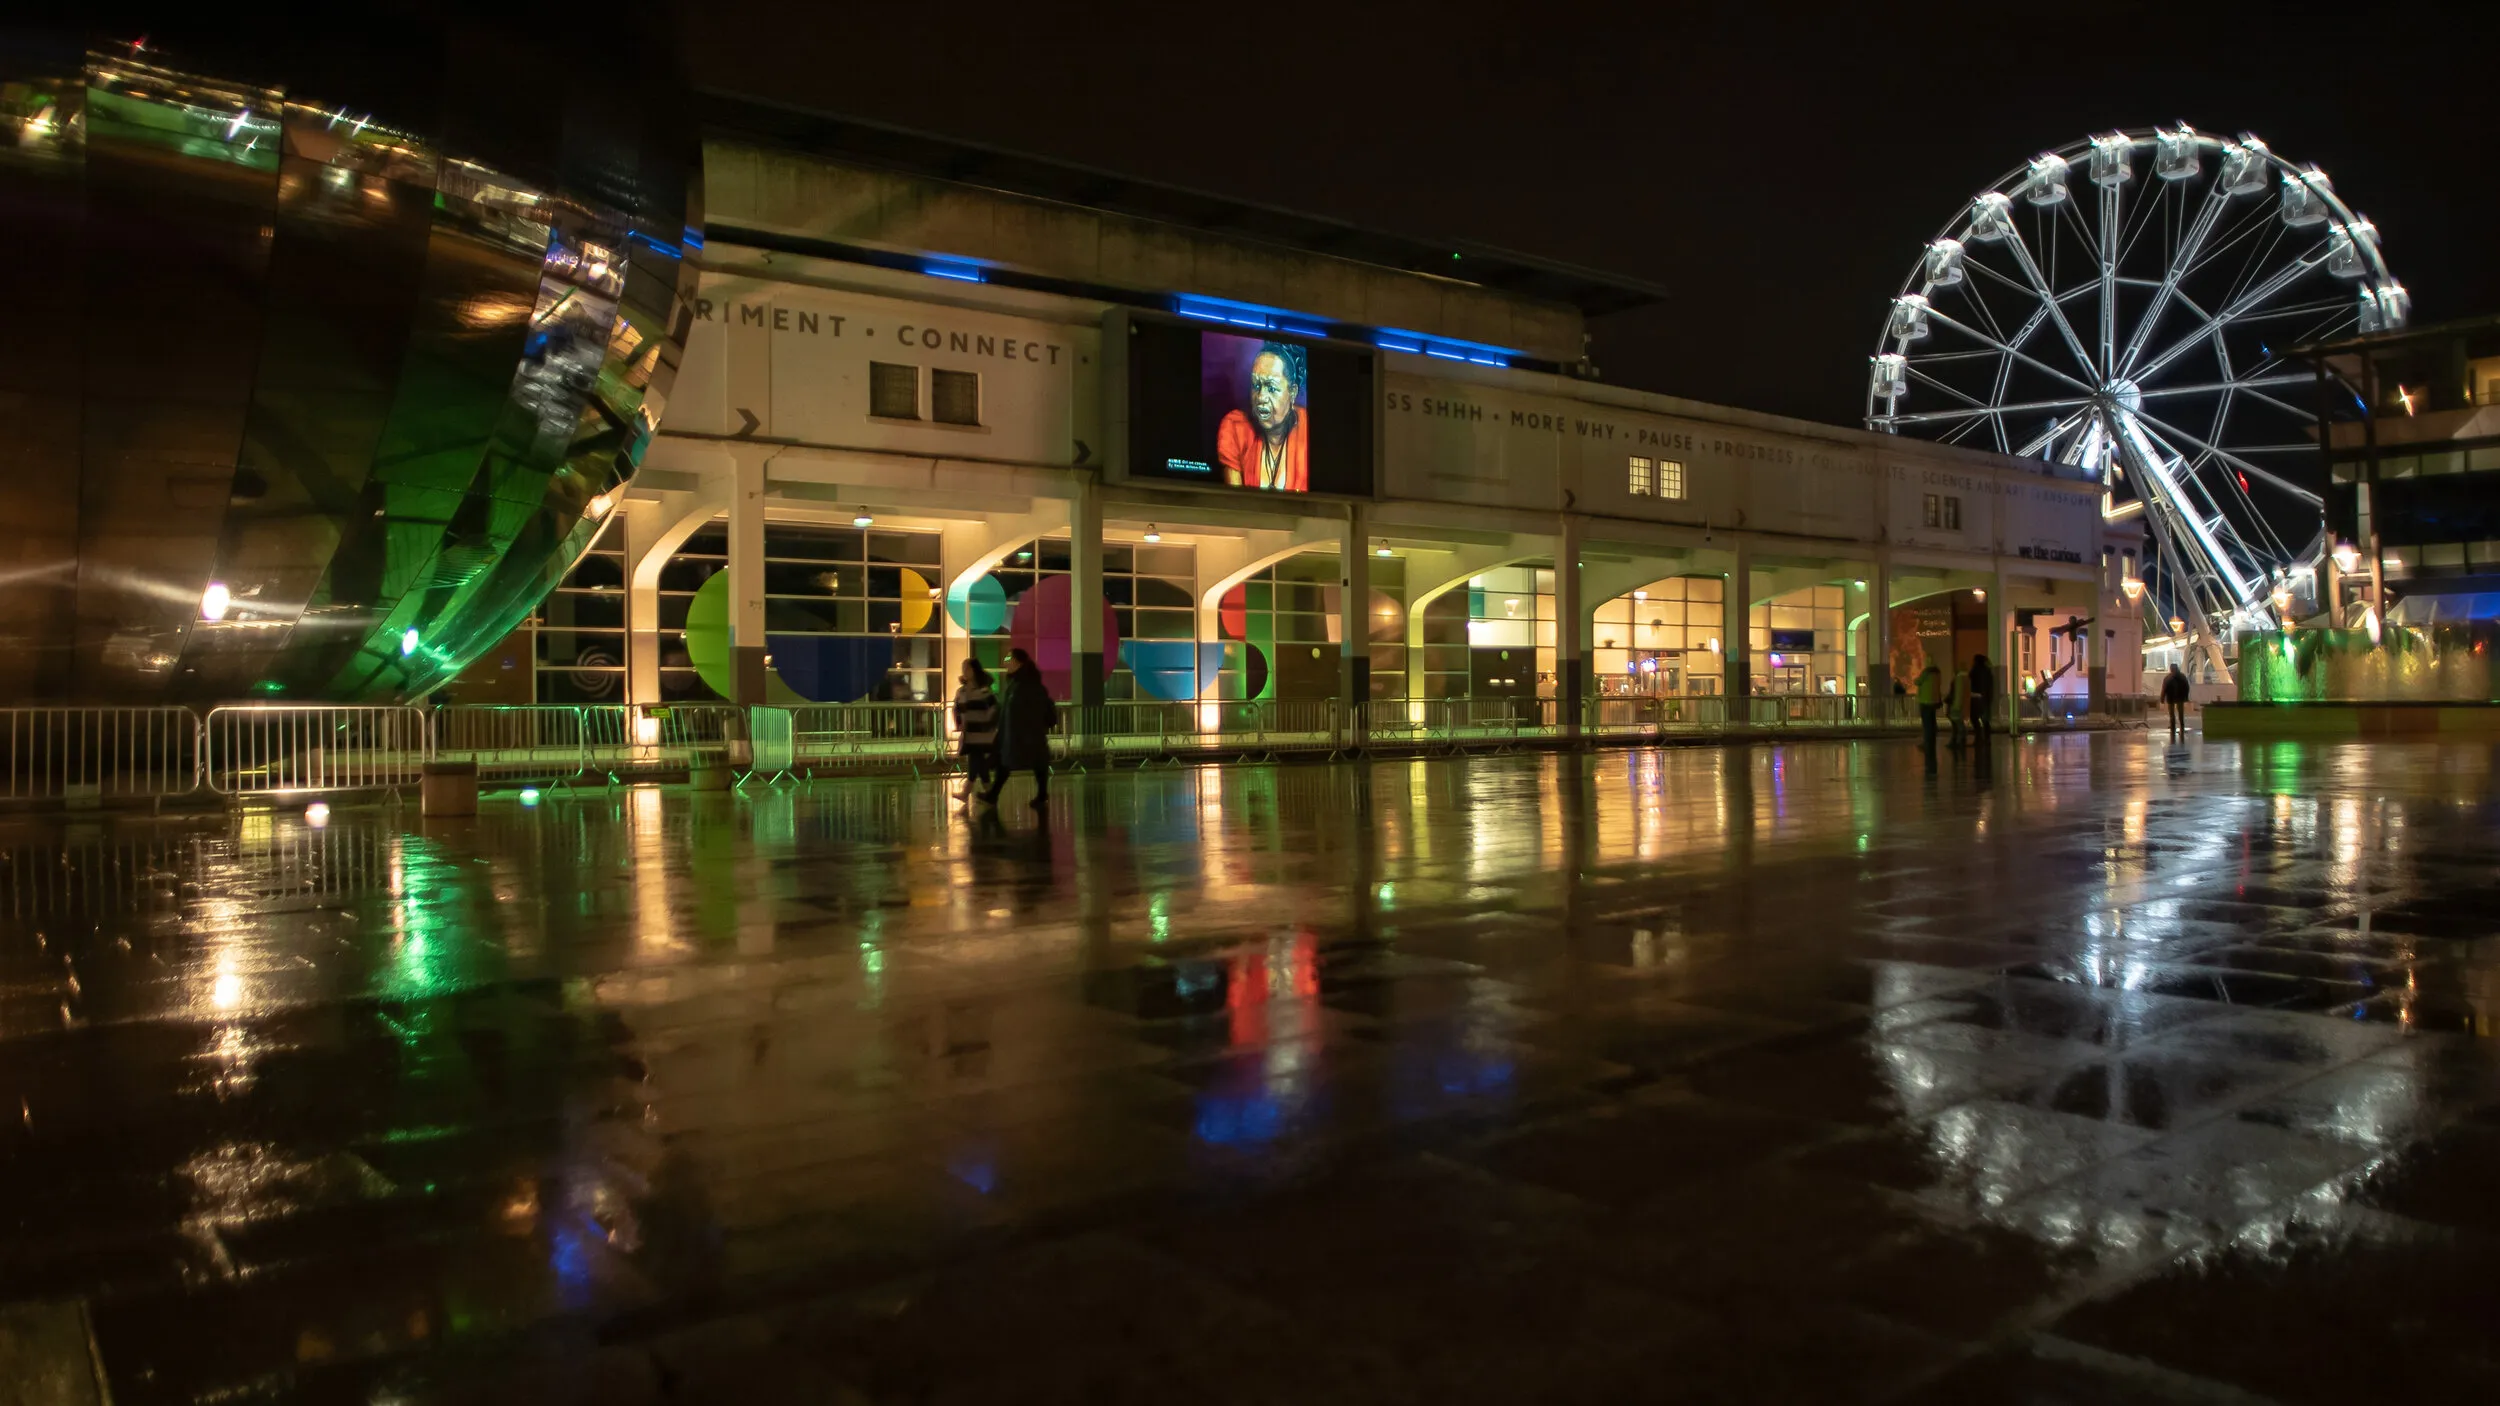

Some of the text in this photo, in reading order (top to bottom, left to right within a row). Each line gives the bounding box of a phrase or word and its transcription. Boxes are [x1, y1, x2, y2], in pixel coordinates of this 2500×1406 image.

[695, 298, 1061, 366] RIMENT CONNECT
[1386, 392, 1412, 412] SS
[1422, 397, 1482, 422] SHHH
[1511, 411, 1565, 433] MORE
[1576, 420, 1616, 440] WHY
[1638, 429, 1693, 451] PAUSE
[1714, 440, 1793, 464] PROGRESS
[1921, 470, 1972, 491] SCIENCE
[1977, 478, 2001, 495] AND
[2018, 544, 2081, 564] we the curious
